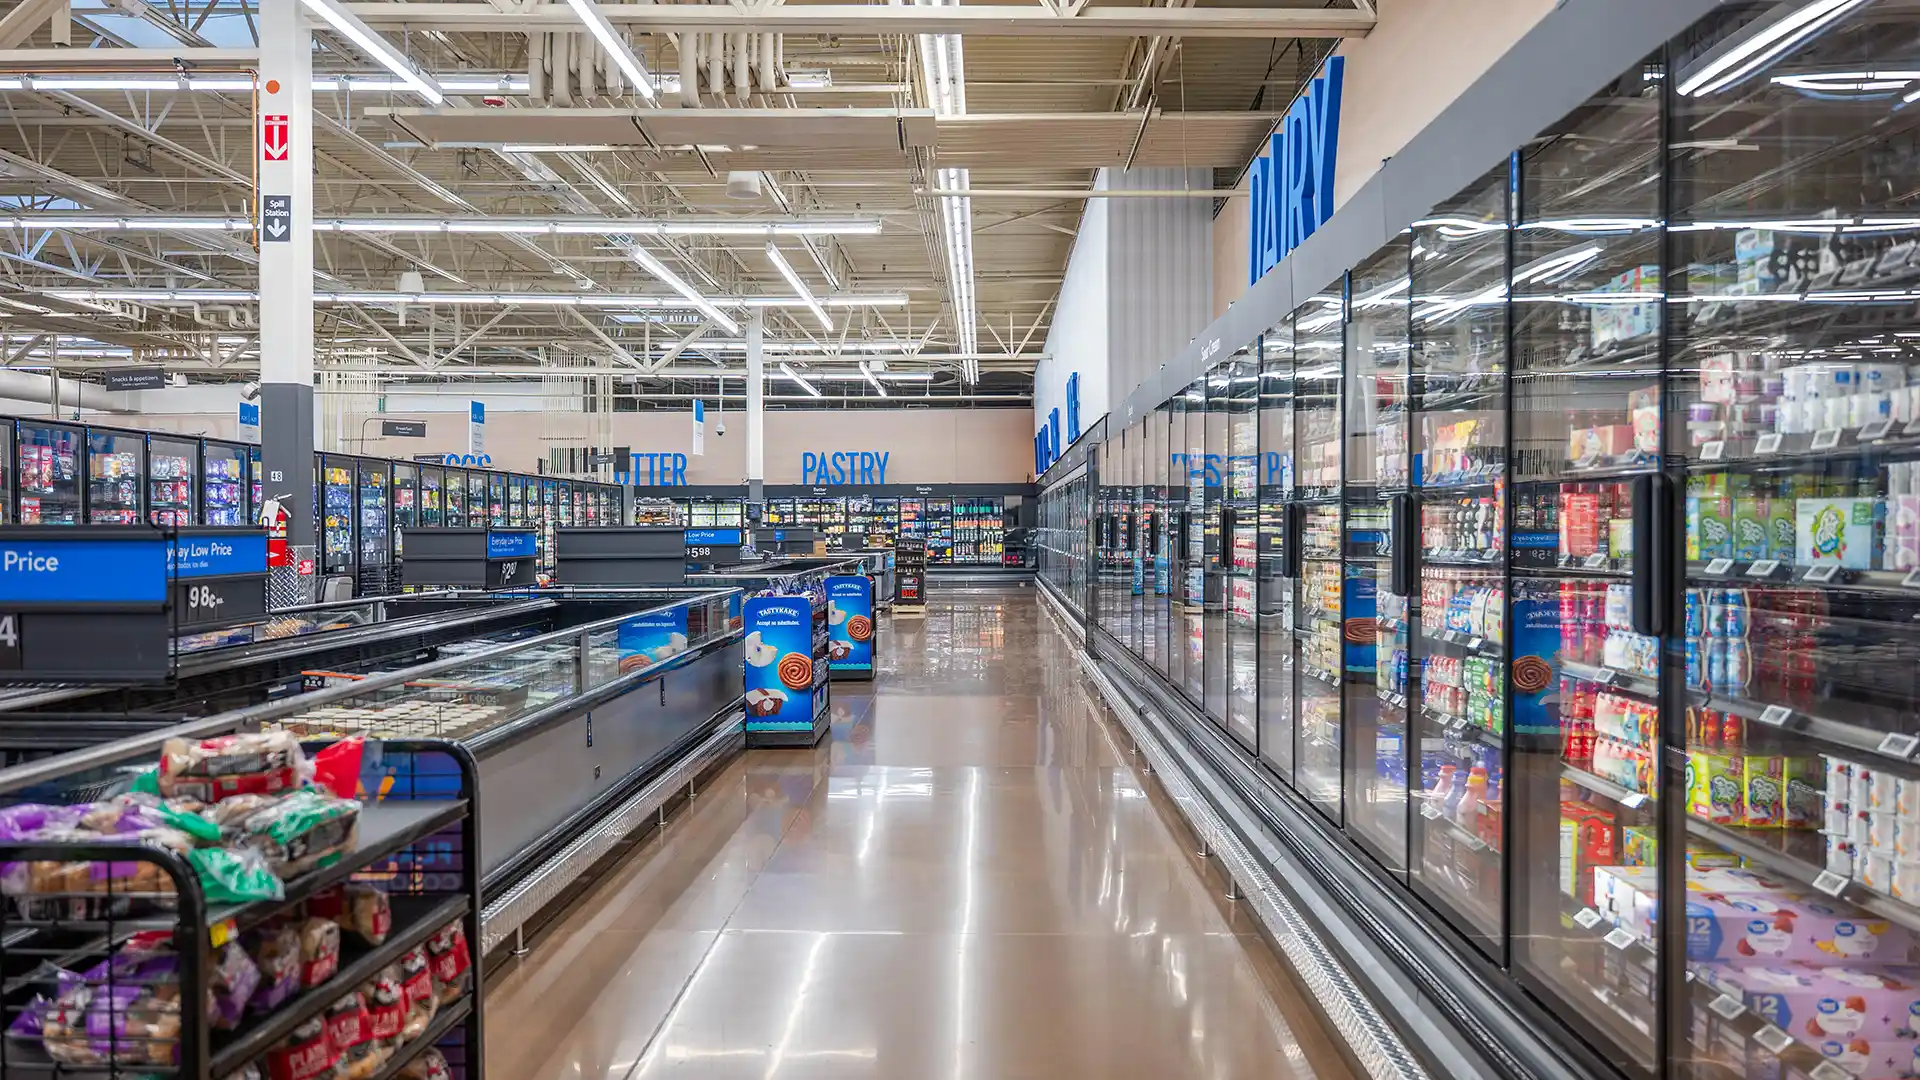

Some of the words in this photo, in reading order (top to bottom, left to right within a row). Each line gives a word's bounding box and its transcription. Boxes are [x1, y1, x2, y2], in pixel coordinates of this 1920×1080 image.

[1249, 56, 1344, 287] DAIRY
[270, 200, 284, 208] Spill
[265, 209, 289, 217] Station
[802, 451, 889, 485] PASTRY
[191, 543, 209, 557] Low
[211, 542, 232, 557] Price
[4, 551, 59, 572] Price
[833, 583, 862, 591] TASTYKAKE
[758, 607, 799, 617] TASTYKAKE
[1688, 917, 1711, 934] 12
[1753, 995, 1778, 1014] 12
